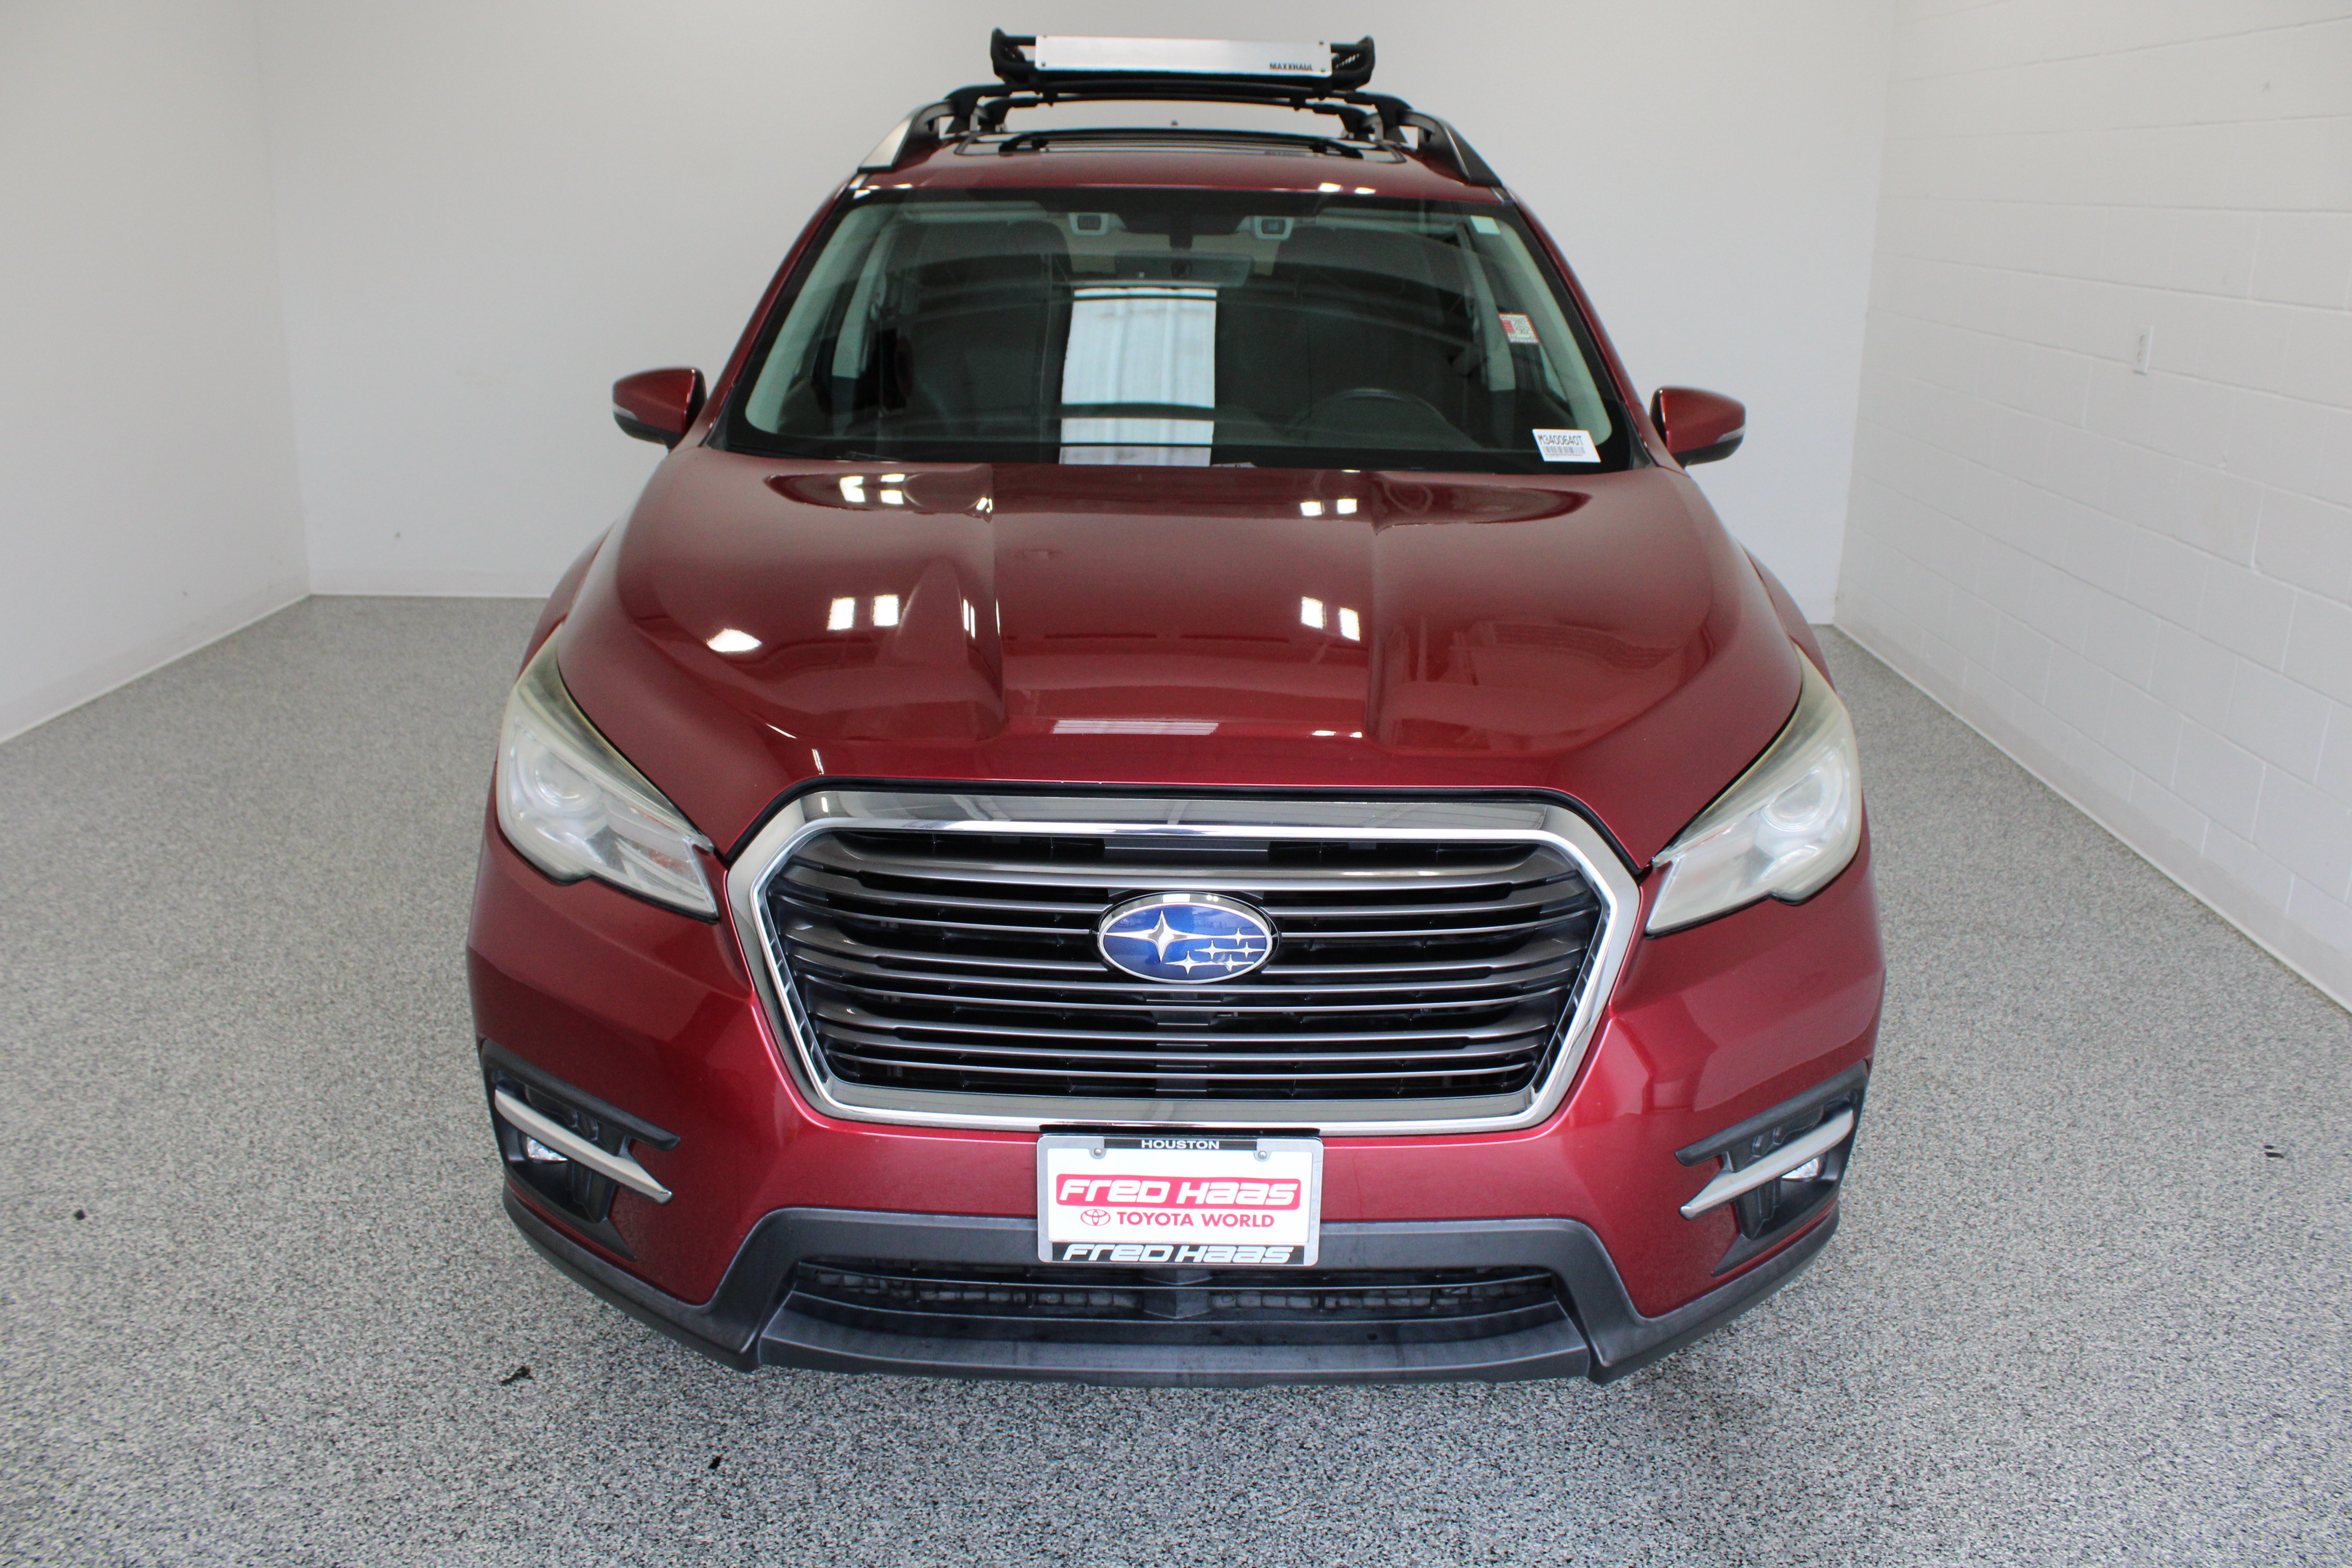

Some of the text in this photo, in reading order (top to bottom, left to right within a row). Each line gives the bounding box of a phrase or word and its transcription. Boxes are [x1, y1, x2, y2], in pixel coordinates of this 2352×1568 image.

[1142, 1140, 1220, 1149] HOUSTON
[1117, 1212, 1274, 1227] TOYOTA WORLD
